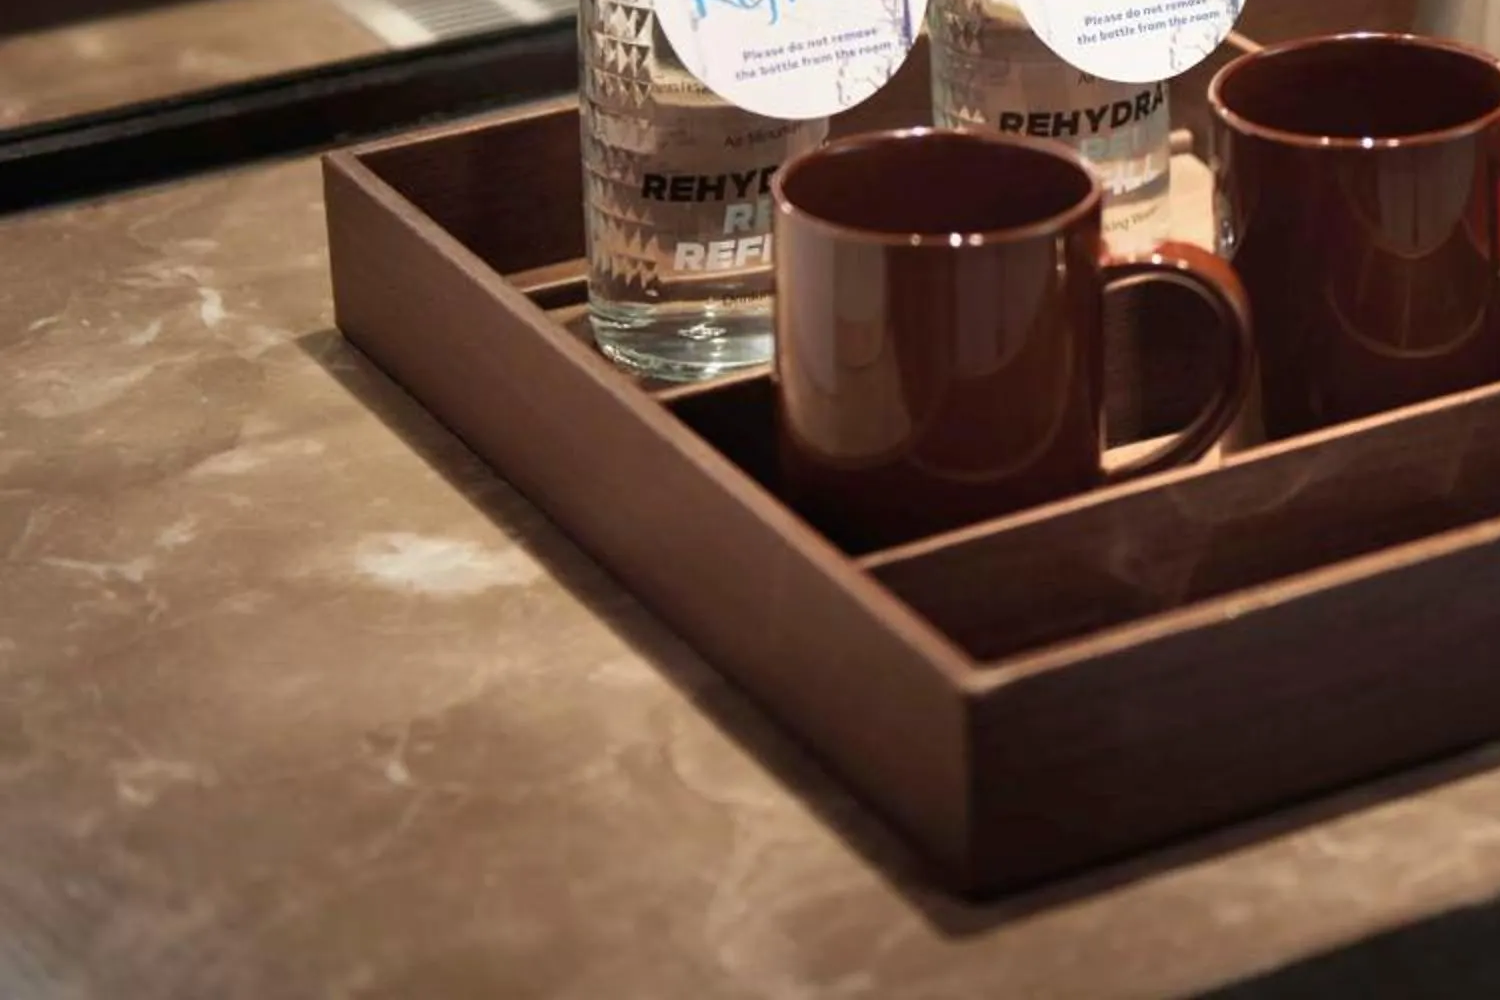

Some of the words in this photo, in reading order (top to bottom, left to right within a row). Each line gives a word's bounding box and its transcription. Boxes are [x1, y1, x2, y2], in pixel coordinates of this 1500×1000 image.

[1077, 33, 1097, 45] the
[1100, 26, 1135, 41] bottle
[1138, 21, 1166, 33] from
[1169, 16, 1188, 27] the
[1190, 10, 1220, 22] room
[1084, 13, 1123, 26] Please
[1125, 8, 1141, 19] do
[1143, 4, 1163, 15] not
[735, 69, 756, 81] the
[760, 59, 799, 76] bottle
[801, 54, 832, 67] from
[835, 48, 856, 59] the
[859, 42, 892, 56] room
[742, 46, 784, 62] Please
[787, 41, 804, 53] do
[807, 36, 828, 48] not
[831, 28, 877, 42] remove
[1000, 82, 1164, 137] REHYDRA
